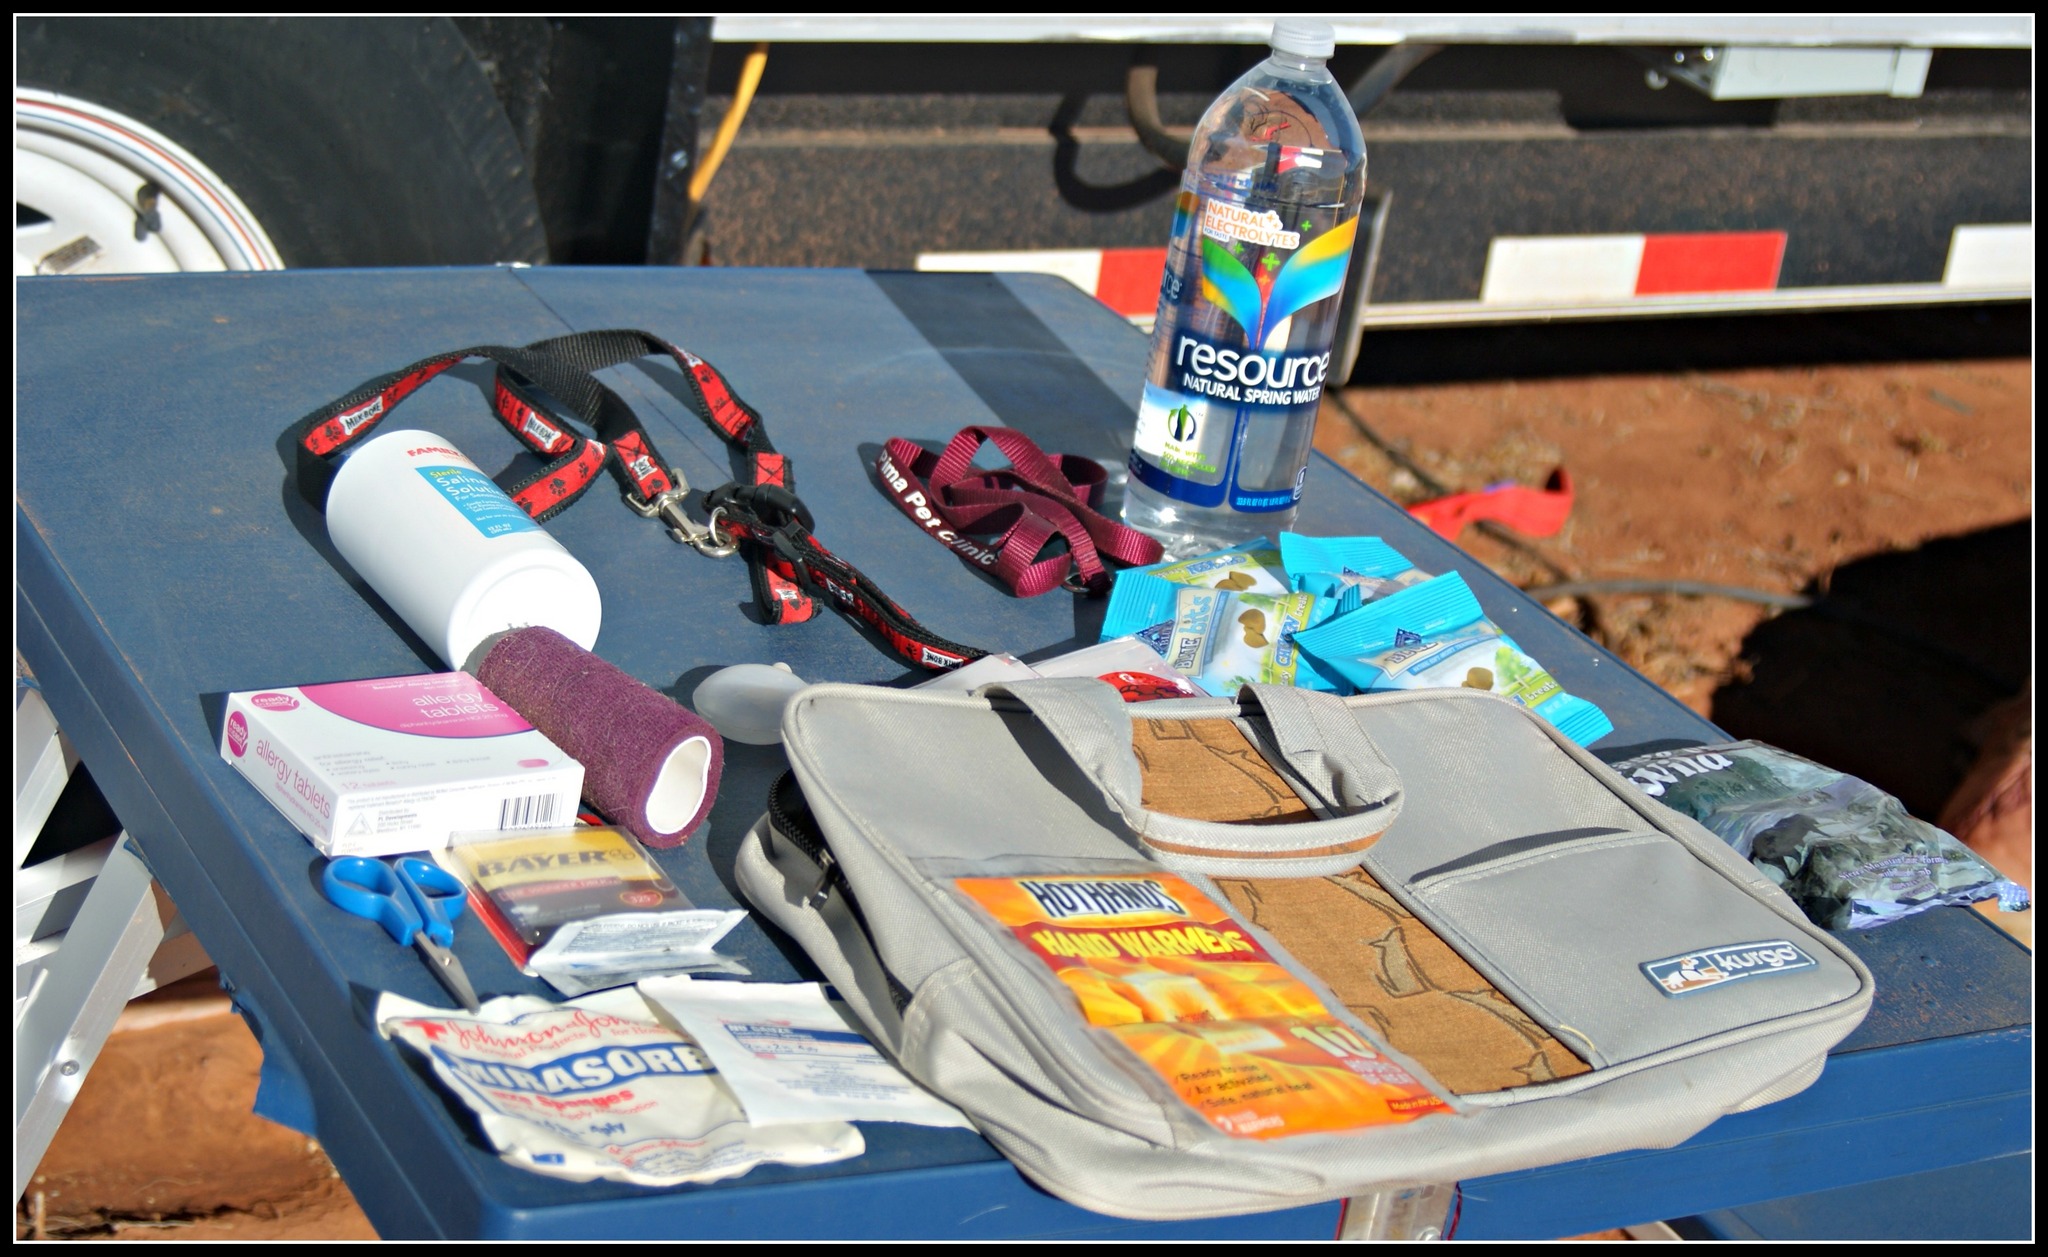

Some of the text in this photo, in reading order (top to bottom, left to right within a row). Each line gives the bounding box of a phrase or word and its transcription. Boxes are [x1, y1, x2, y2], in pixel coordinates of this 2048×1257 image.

[1207, 201, 1265, 228] NATURAL
[1204, 227, 1213, 235] FOR
[1205, 215, 1298, 247] ELECTROLYTES
[1176, 335, 1330, 388] resource
[1183, 373, 1321, 406] NATURAL SPRING WATER
[430, 467, 463, 479] Sterile
[437, 475, 489, 487] Saline
[879, 449, 995, 565] Pima Pet Clinic
[1180, 595, 1213, 634] bits
[1175, 637, 1202, 668] BLUE
[412, 692, 484, 706] allergy
[420, 703, 499, 718] tablets
[229, 718, 248, 740] ready
[256, 739, 292, 785] allergy
[293, 770, 331, 819] tablets
[478, 851, 608, 878] BAYER
[1018, 880, 1187, 918] HOTHANDS
[1031, 926, 1255, 958] HAND WARMERS
[1713, 945, 1798, 971] kurgo
[446, 1019, 565, 1050] Johnson
[1289, 1026, 1377, 1059] 10
[1180, 1069, 1222, 1081] Ready
[1216, 1074, 1272, 1091] activated
[535, 1090, 635, 1111] Sponges
[1242, 1086, 1285, 1099] natural
[1392, 1101, 1410, 1110] Made
